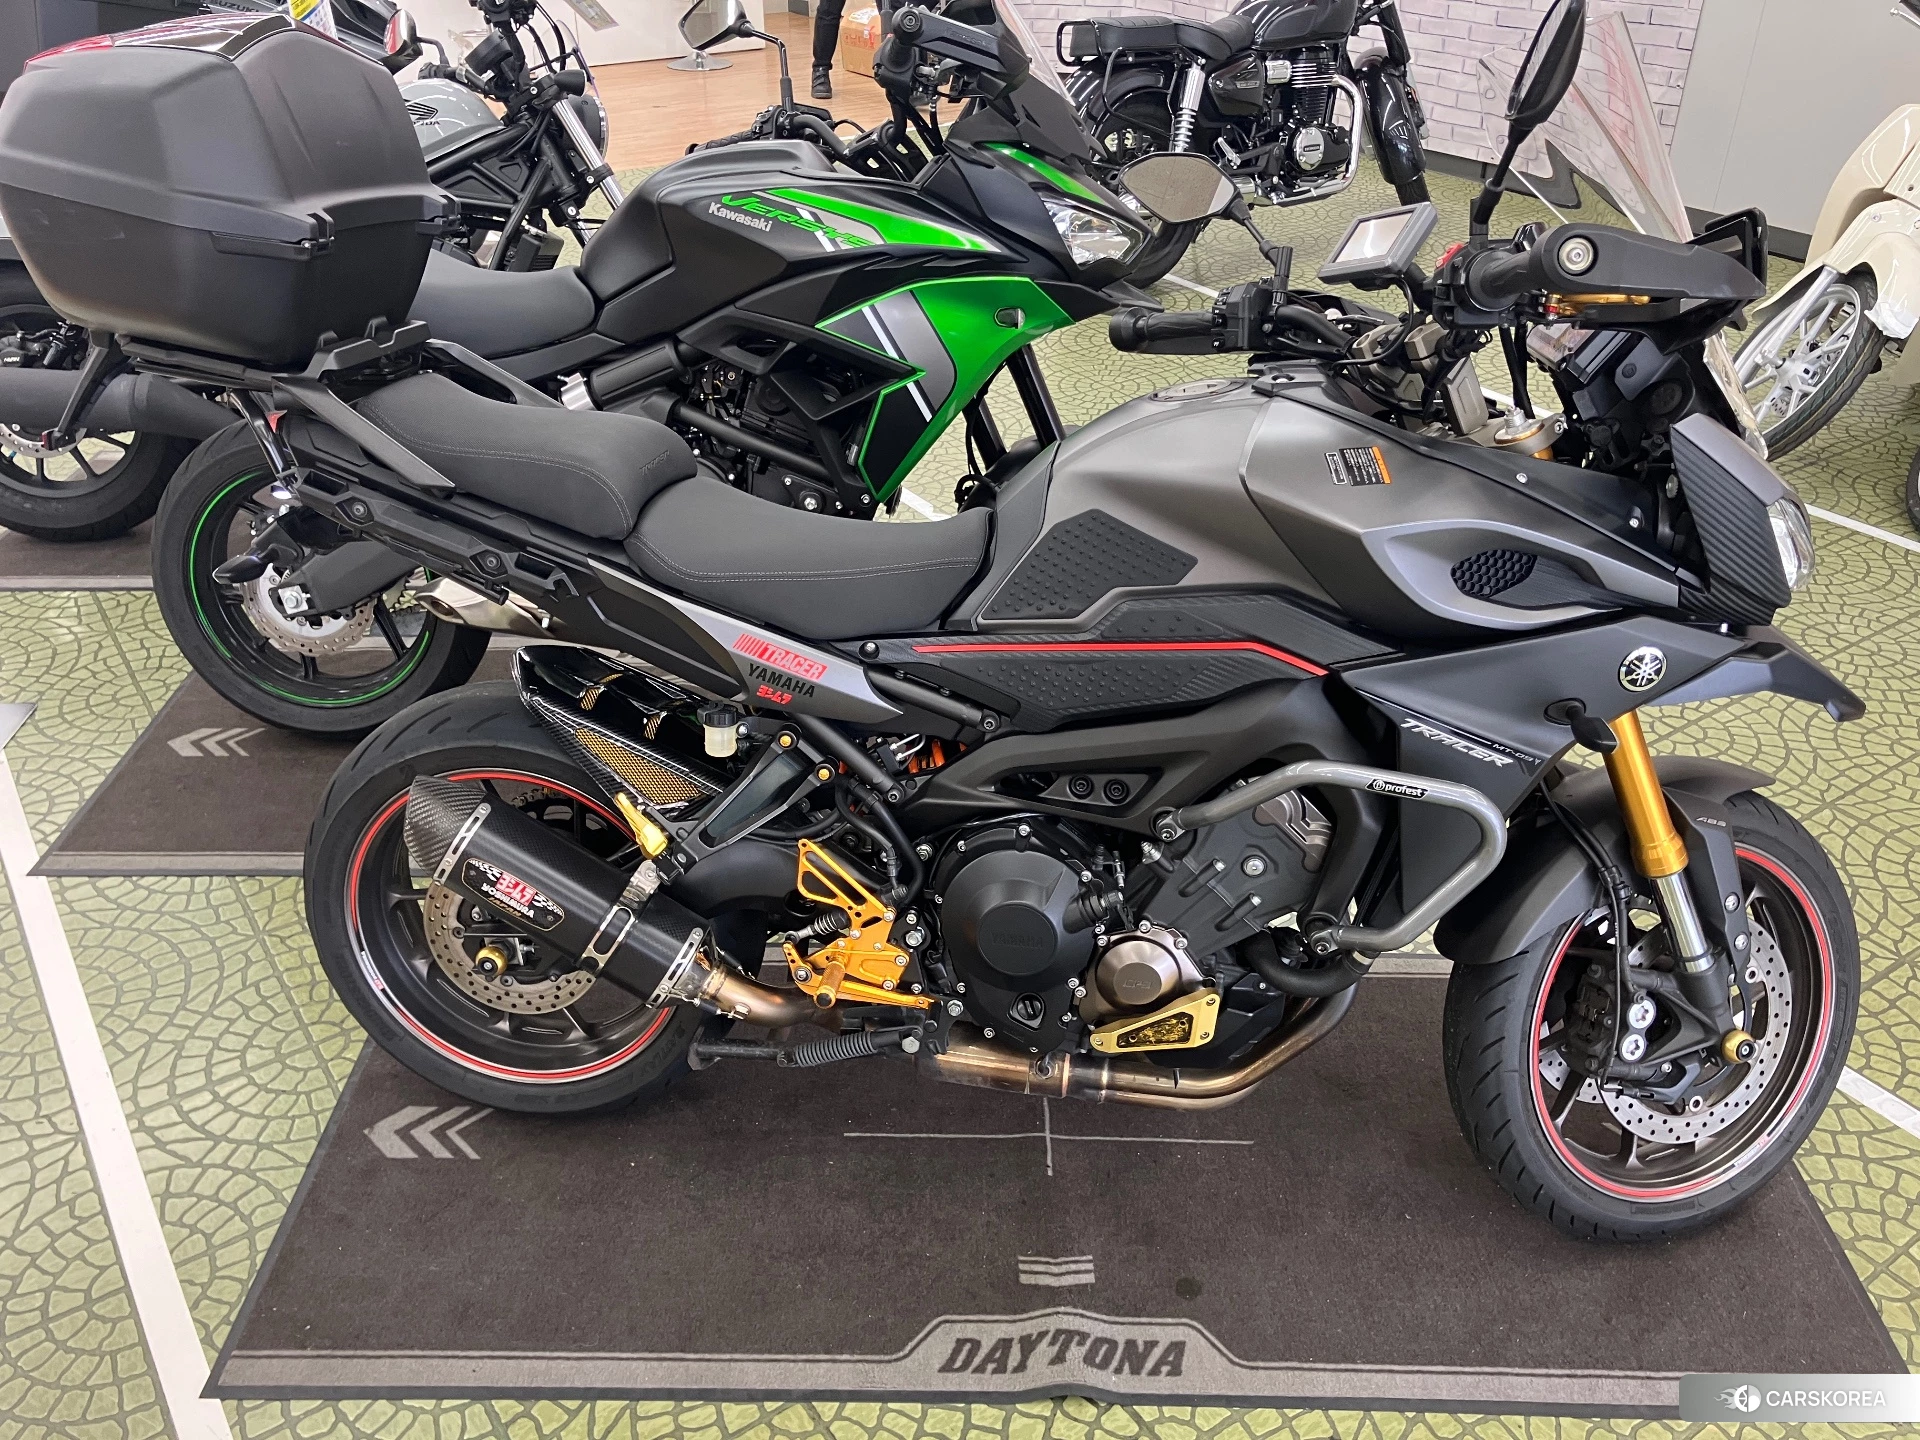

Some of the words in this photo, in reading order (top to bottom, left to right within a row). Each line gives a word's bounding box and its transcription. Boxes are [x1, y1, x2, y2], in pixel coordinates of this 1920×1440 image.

[708, 202, 772, 232] Kawasaki
[722, 195, 877, 248] VERSYS
[748, 663, 815, 698] YAMAHA
[761, 644, 824, 681] TRACER
[1400, 718, 1514, 768] TRACER
[1493, 743, 1534, 762] MT-09
[1385, 784, 1423, 797] profest
[480, 882, 536, 919] YOSHIMURA
[937, 1328, 1187, 1377] DAYTONA
